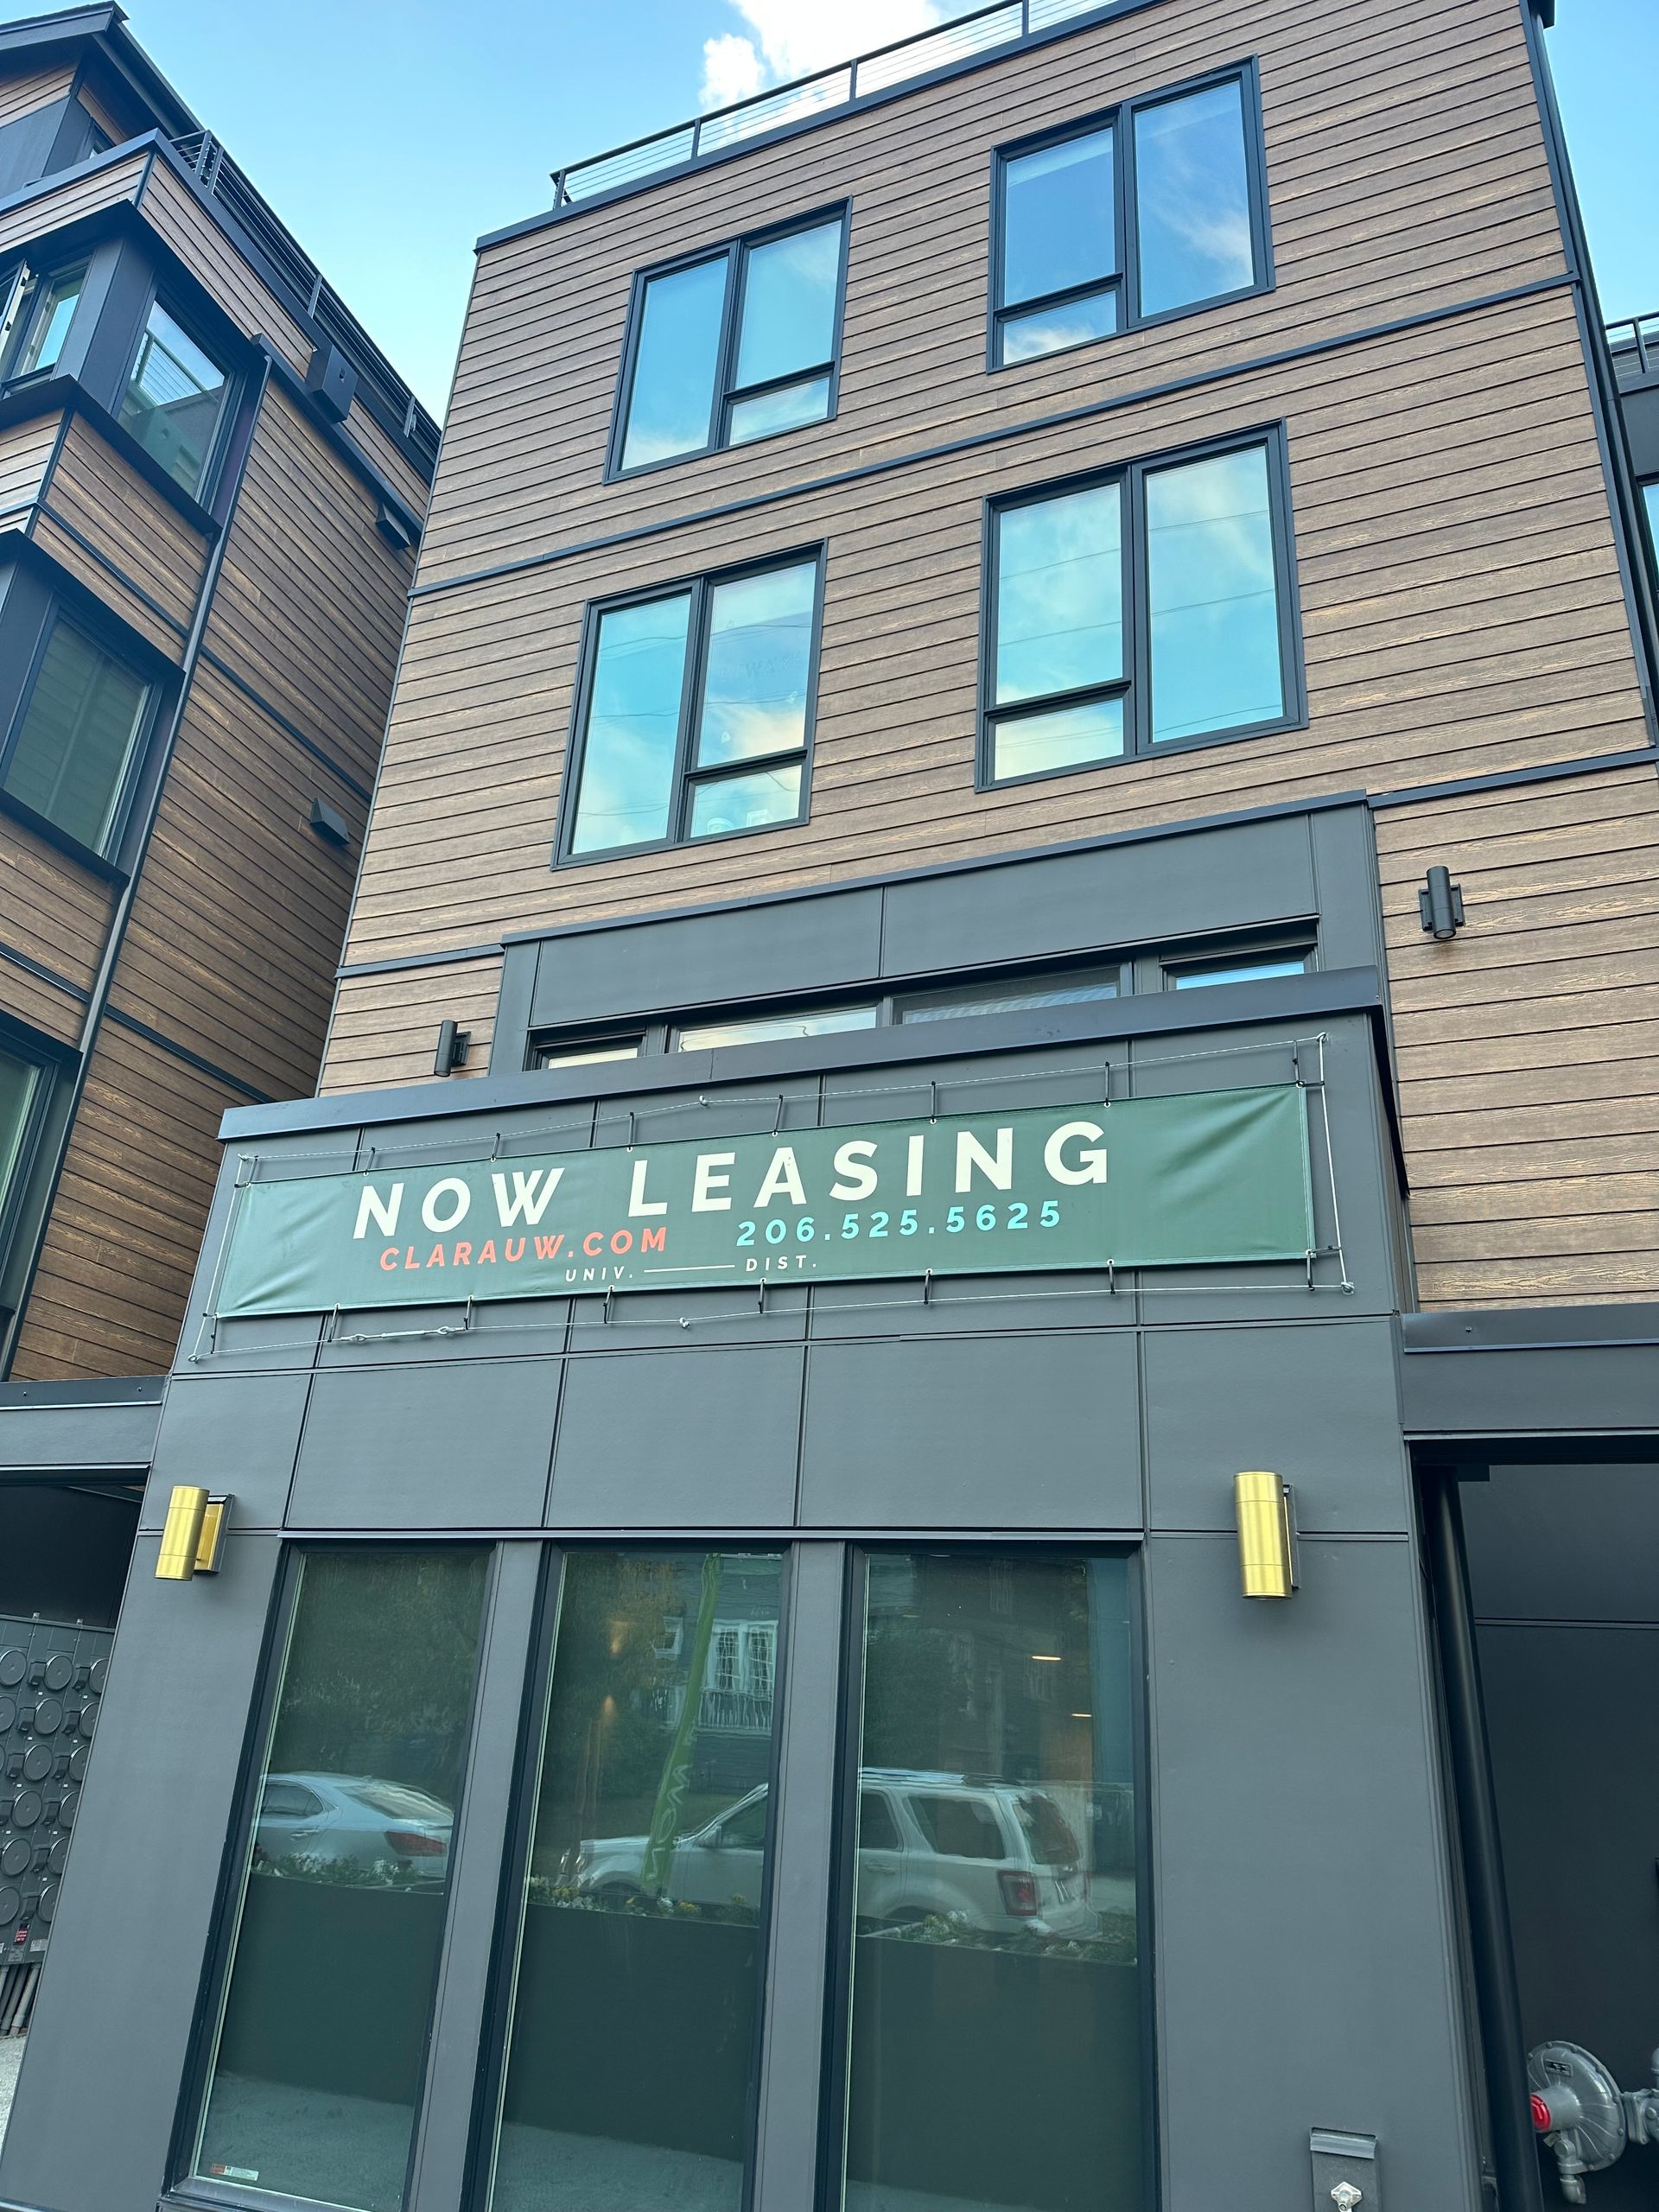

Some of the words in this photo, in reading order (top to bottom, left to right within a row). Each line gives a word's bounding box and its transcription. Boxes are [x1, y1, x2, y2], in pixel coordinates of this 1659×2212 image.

[353, 1167, 566, 1240] NOW
[627, 1121, 1108, 1217] LEASING
[735, 1199, 1061, 1247] 206.525.5625
[379, 1227, 667, 1272] CLARAUW.COM
[565, 1265, 633, 1283] UNIV.
[746, 1255, 817, 1272] DIST.
